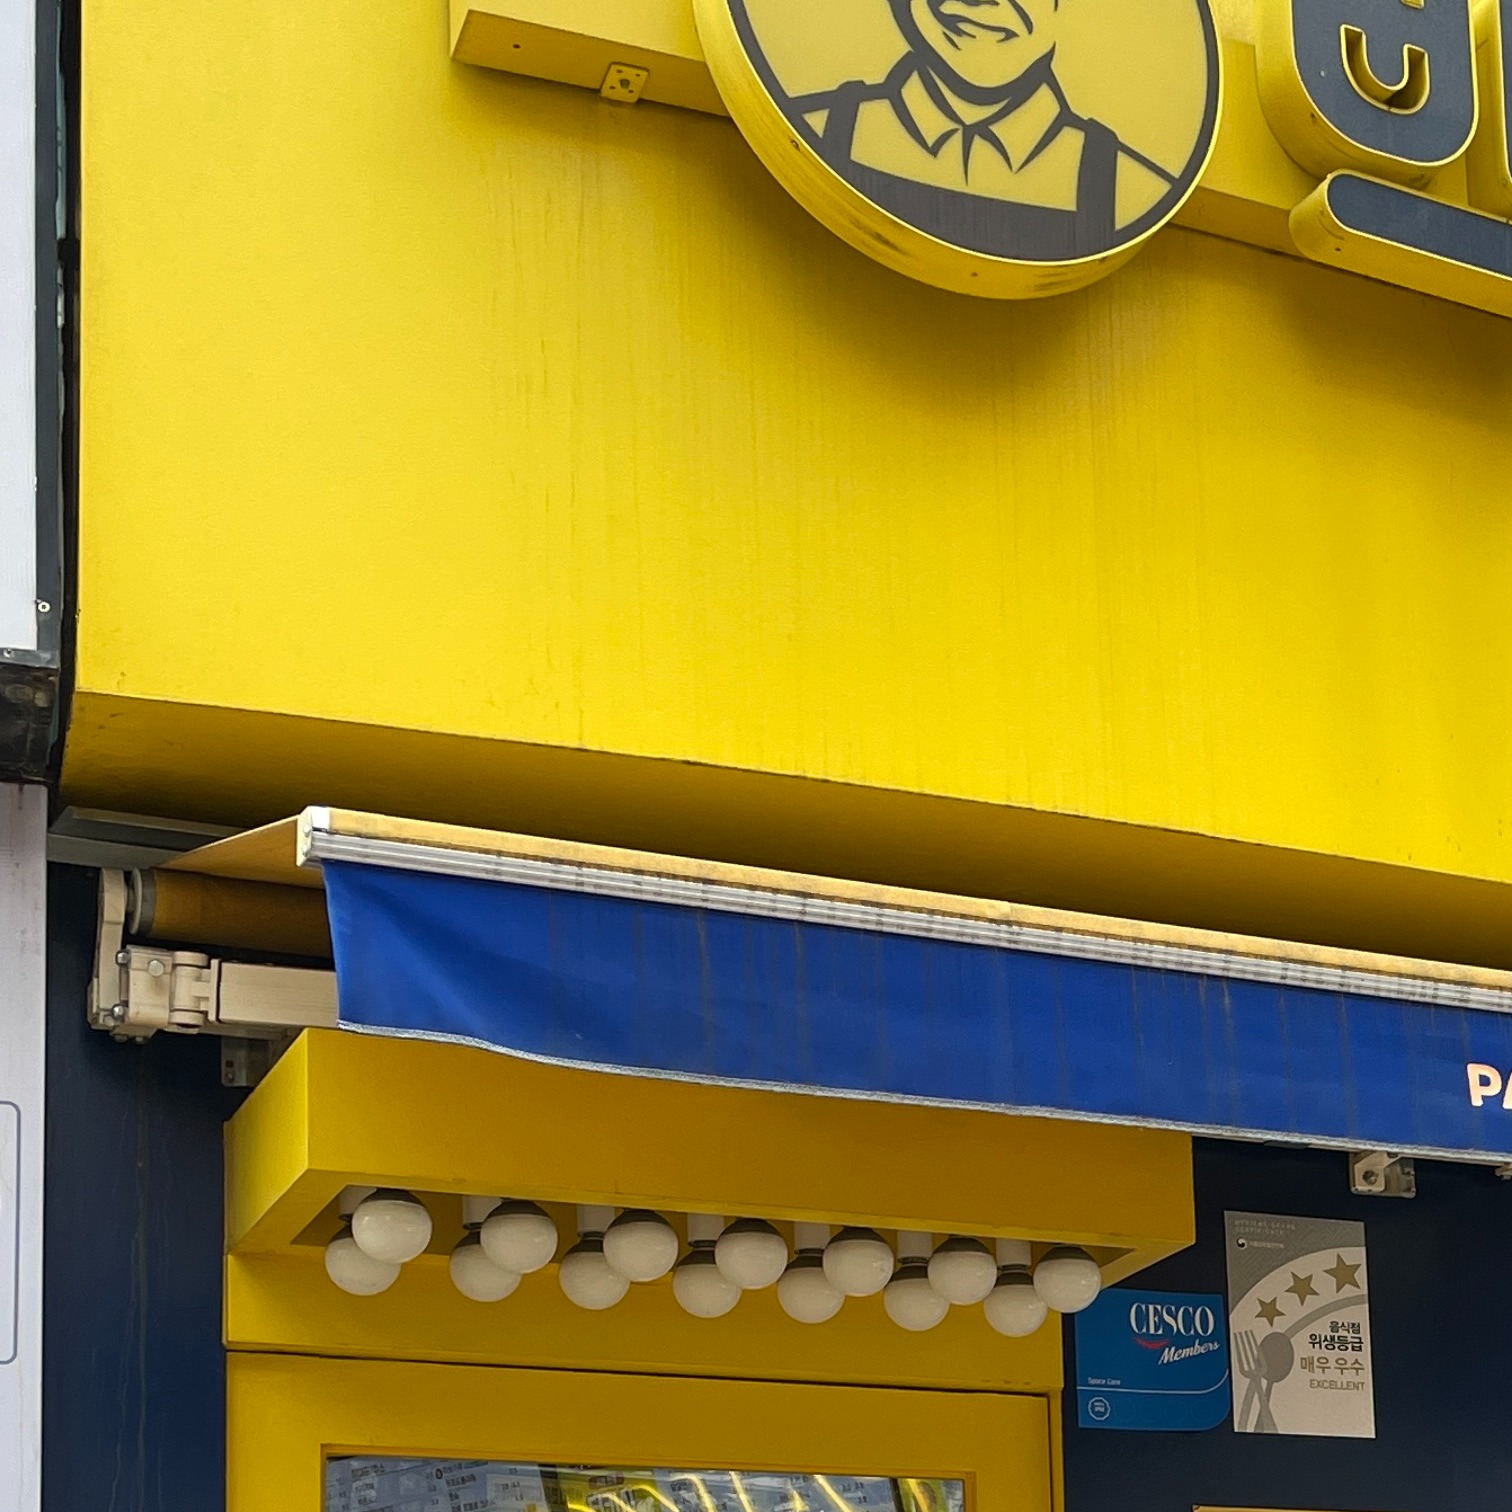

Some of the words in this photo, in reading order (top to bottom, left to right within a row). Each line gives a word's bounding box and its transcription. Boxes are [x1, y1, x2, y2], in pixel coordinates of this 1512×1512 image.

[1129, 1301, 1215, 1337] CESCO
[1328, 1320, 1361, 1335] 음식점
[1157, 1339, 1221, 1366] Members
[1308, 1332, 1364, 1353] 위생등급
[1300, 1355, 1331, 1375] 매우
[1333, 1356, 1365, 1376] 우수
[1309, 1379, 1366, 1391] EXCELLENT
